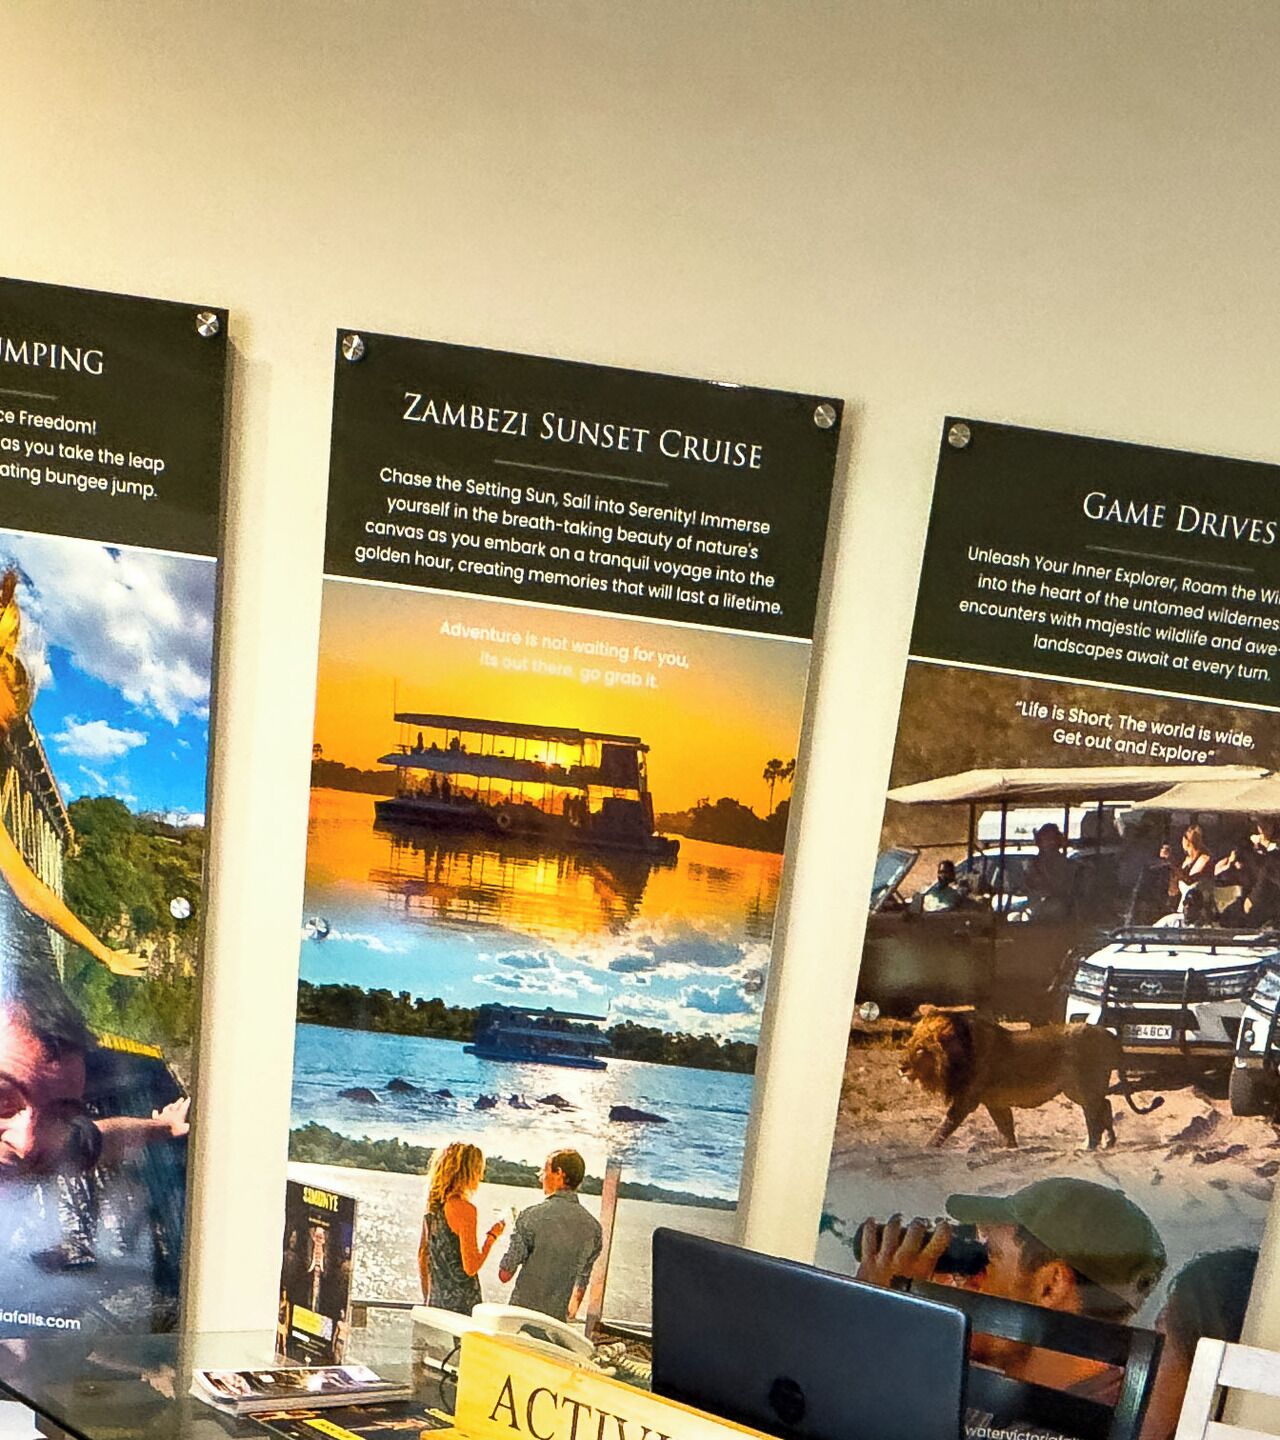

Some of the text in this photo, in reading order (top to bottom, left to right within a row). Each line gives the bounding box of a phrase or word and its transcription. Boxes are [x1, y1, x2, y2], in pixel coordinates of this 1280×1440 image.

[19, 410, 96, 434] Freedom!
[0, 437, 20, 451] as
[24, 440, 54, 457] you
[58, 443, 94, 461] take
[97, 448, 124, 466] the
[128, 452, 165, 475] leap
[45, 467, 108, 492] bungee
[110, 477, 158, 500] jump.
[379, 467, 770, 534] Chase the Setting Sun, Sail into Serenity! Immerse
[387, 497, 451, 516] yourself
[453, 502, 468, 519] in
[472, 506, 498, 523] the
[501, 510, 613, 543] breath-taking
[616, 526, 673, 551] beauty
[676, 535, 693, 550] of
[365, 521, 775, 588] canvas as you embark on a tranquil voyage into the
[968, 546, 1030, 568] Unleash
[1034, 555, 1069, 573] Your
[1071, 562, 1112, 579] Inner
[1114, 567, 1178, 591] Explorer,
[1181, 577, 1227, 596] Roam
[1231, 584, 1256, 601] the
[977, 573, 1008, 591] into
[1011, 578, 1036, 595] the
[1039, 582, 1082, 602] heart
[1084, 590, 1102, 604] of
[1104, 592, 1129, 609] the
[1132, 599, 1204, 619] untamed
[958, 600, 1046, 622] encounters
[1050, 611, 1082, 627] with
[1085, 618, 1151, 638] majestic
[1155, 627, 1208, 646] wildlife
[1210, 636, 1242, 651] and
[1052, 704, 1065, 720] is
[1067, 707, 1114, 728] Short,
[1118, 714, 1147, 732] The
[1150, 722, 1196, 739] world
[1198, 725, 1211, 741] is
[1214, 729, 1255, 749] wide,
[1052, 728, 1082, 746] Get
[1084, 735, 1112, 750] out
[1114, 739, 1147, 756] and
